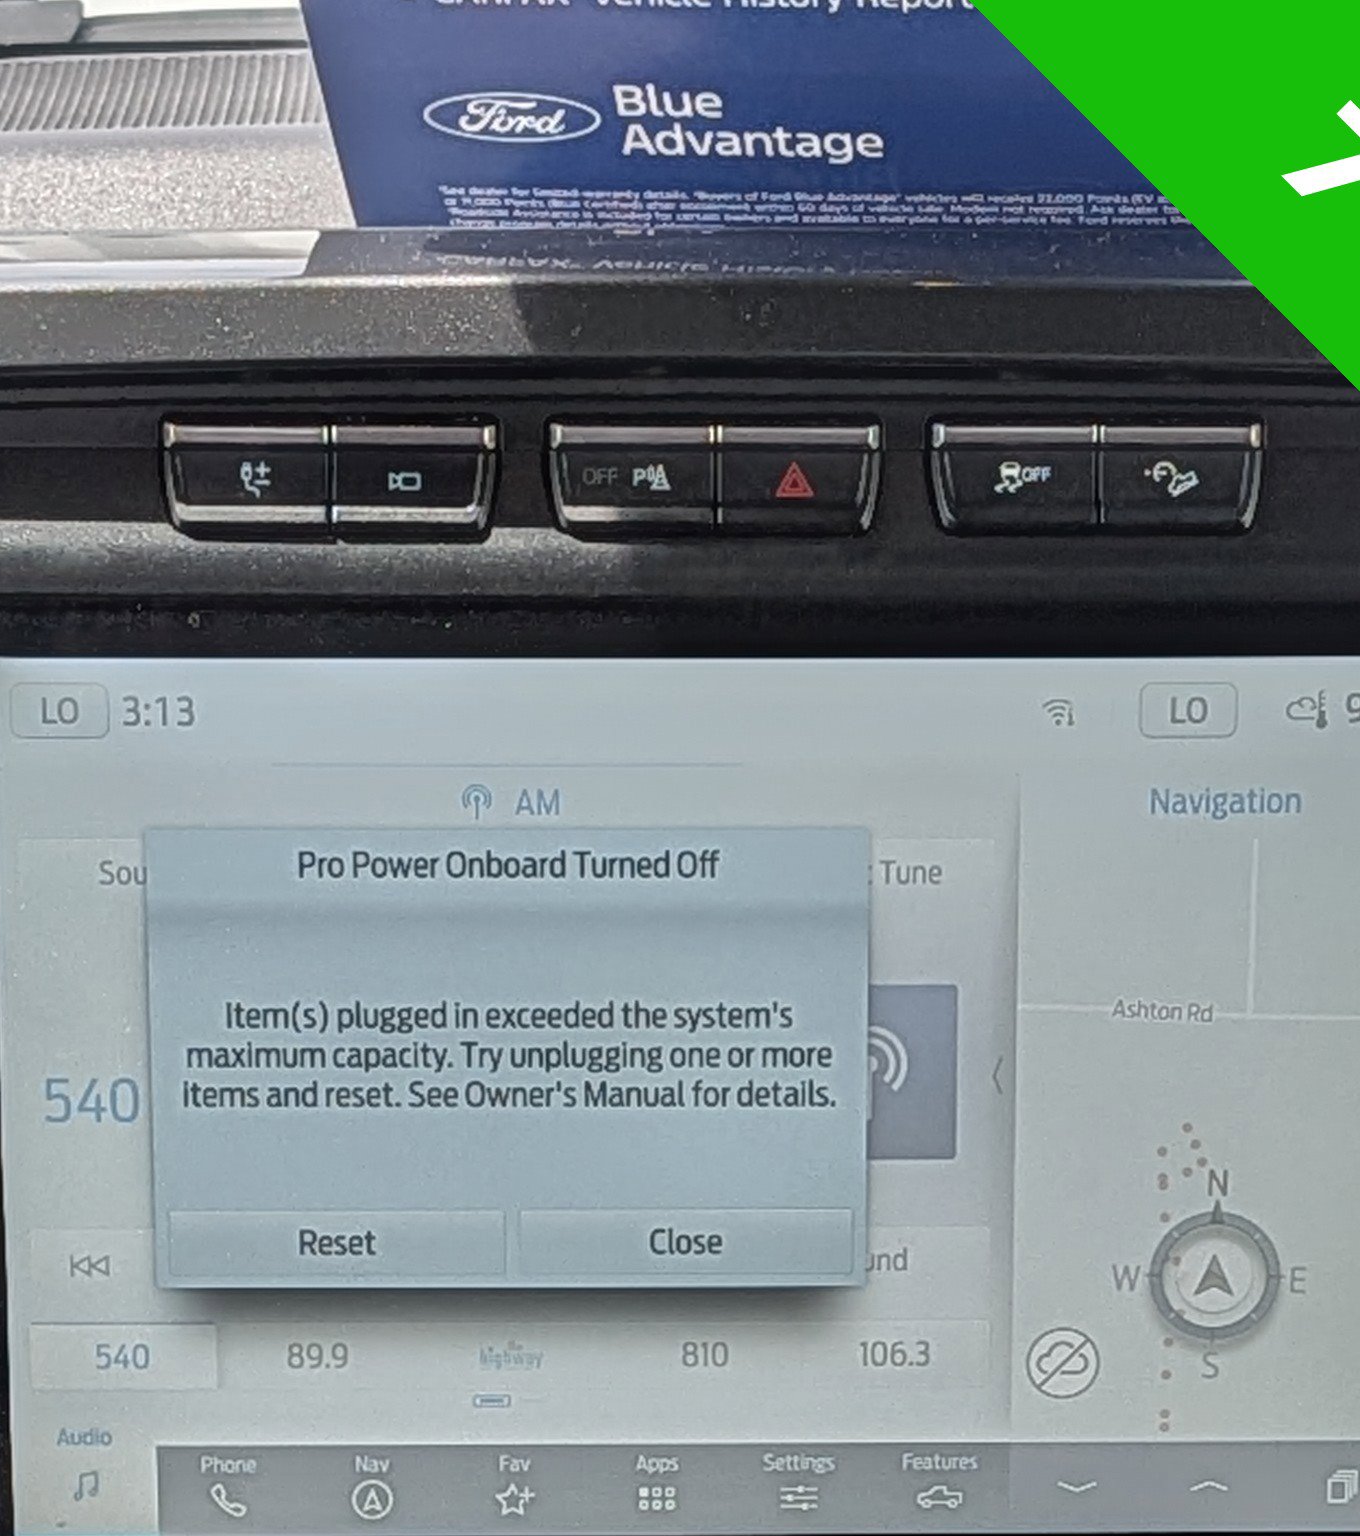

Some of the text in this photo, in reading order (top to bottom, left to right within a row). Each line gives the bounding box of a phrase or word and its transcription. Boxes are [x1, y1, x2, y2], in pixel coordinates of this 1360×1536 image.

[613, 84, 723, 119] Blue
[623, 125, 884, 165] Advantage
[744, 191, 758, 201] of
[761, 191, 791, 201] Ford
[794, 192, 824, 202] Blue
[905, 192, 958, 203] vehicles
[797, 203, 816, 213] 60
[819, 203, 849, 215] days
[851, 203, 865, 213] of
[1002, 205, 1024, 215] not
[1090, 205, 1115, 215] Ask
[1078, 216, 1109, 226] Ford
[582, 467, 619, 486] OFF
[1021, 466, 1052, 483] OFF
[40, 696, 197, 729] LO 3:13
[1168, 695, 1209, 725] LO
[514, 789, 561, 817] AM
[1149, 787, 1302, 820] Navigation
[298, 849, 720, 879] Pro Power Onboard Turned Off
[879, 859, 943, 886] Tune
[225, 1000, 793, 1034] Item(s) plugged in exceeded the system's
[1111, 999, 1214, 1023] Ashton Rd
[186, 1040, 833, 1074] maximum capacity. Try unplugging one or more
[44, 1077, 140, 1125] 540
[182, 1079, 836, 1108] items and reset. See Owner's Manual for details.
[1208, 1168, 1229, 1197] N
[298, 1229, 377, 1256] Reset
[648, 1229, 723, 1256] Close
[1111, 1265, 1141, 1292] W
[1288, 1266, 1307, 1295] E
[94, 1344, 151, 1371] 540
[286, 1343, 349, 1370] 89.9
[680, 1341, 730, 1369] 810
[859, 1341, 932, 1369] 106.3
[1201, 1352, 1221, 1380] S
[56, 1426, 113, 1448] Audio
[200, 1455, 258, 1475] Phone
[354, 1455, 390, 1474] Nav
[498, 1455, 531, 1474] Fav
[635, 1455, 680, 1478] Apps
[762, 1452, 837, 1476] Settings
[901, 1452, 979, 1473] Features
